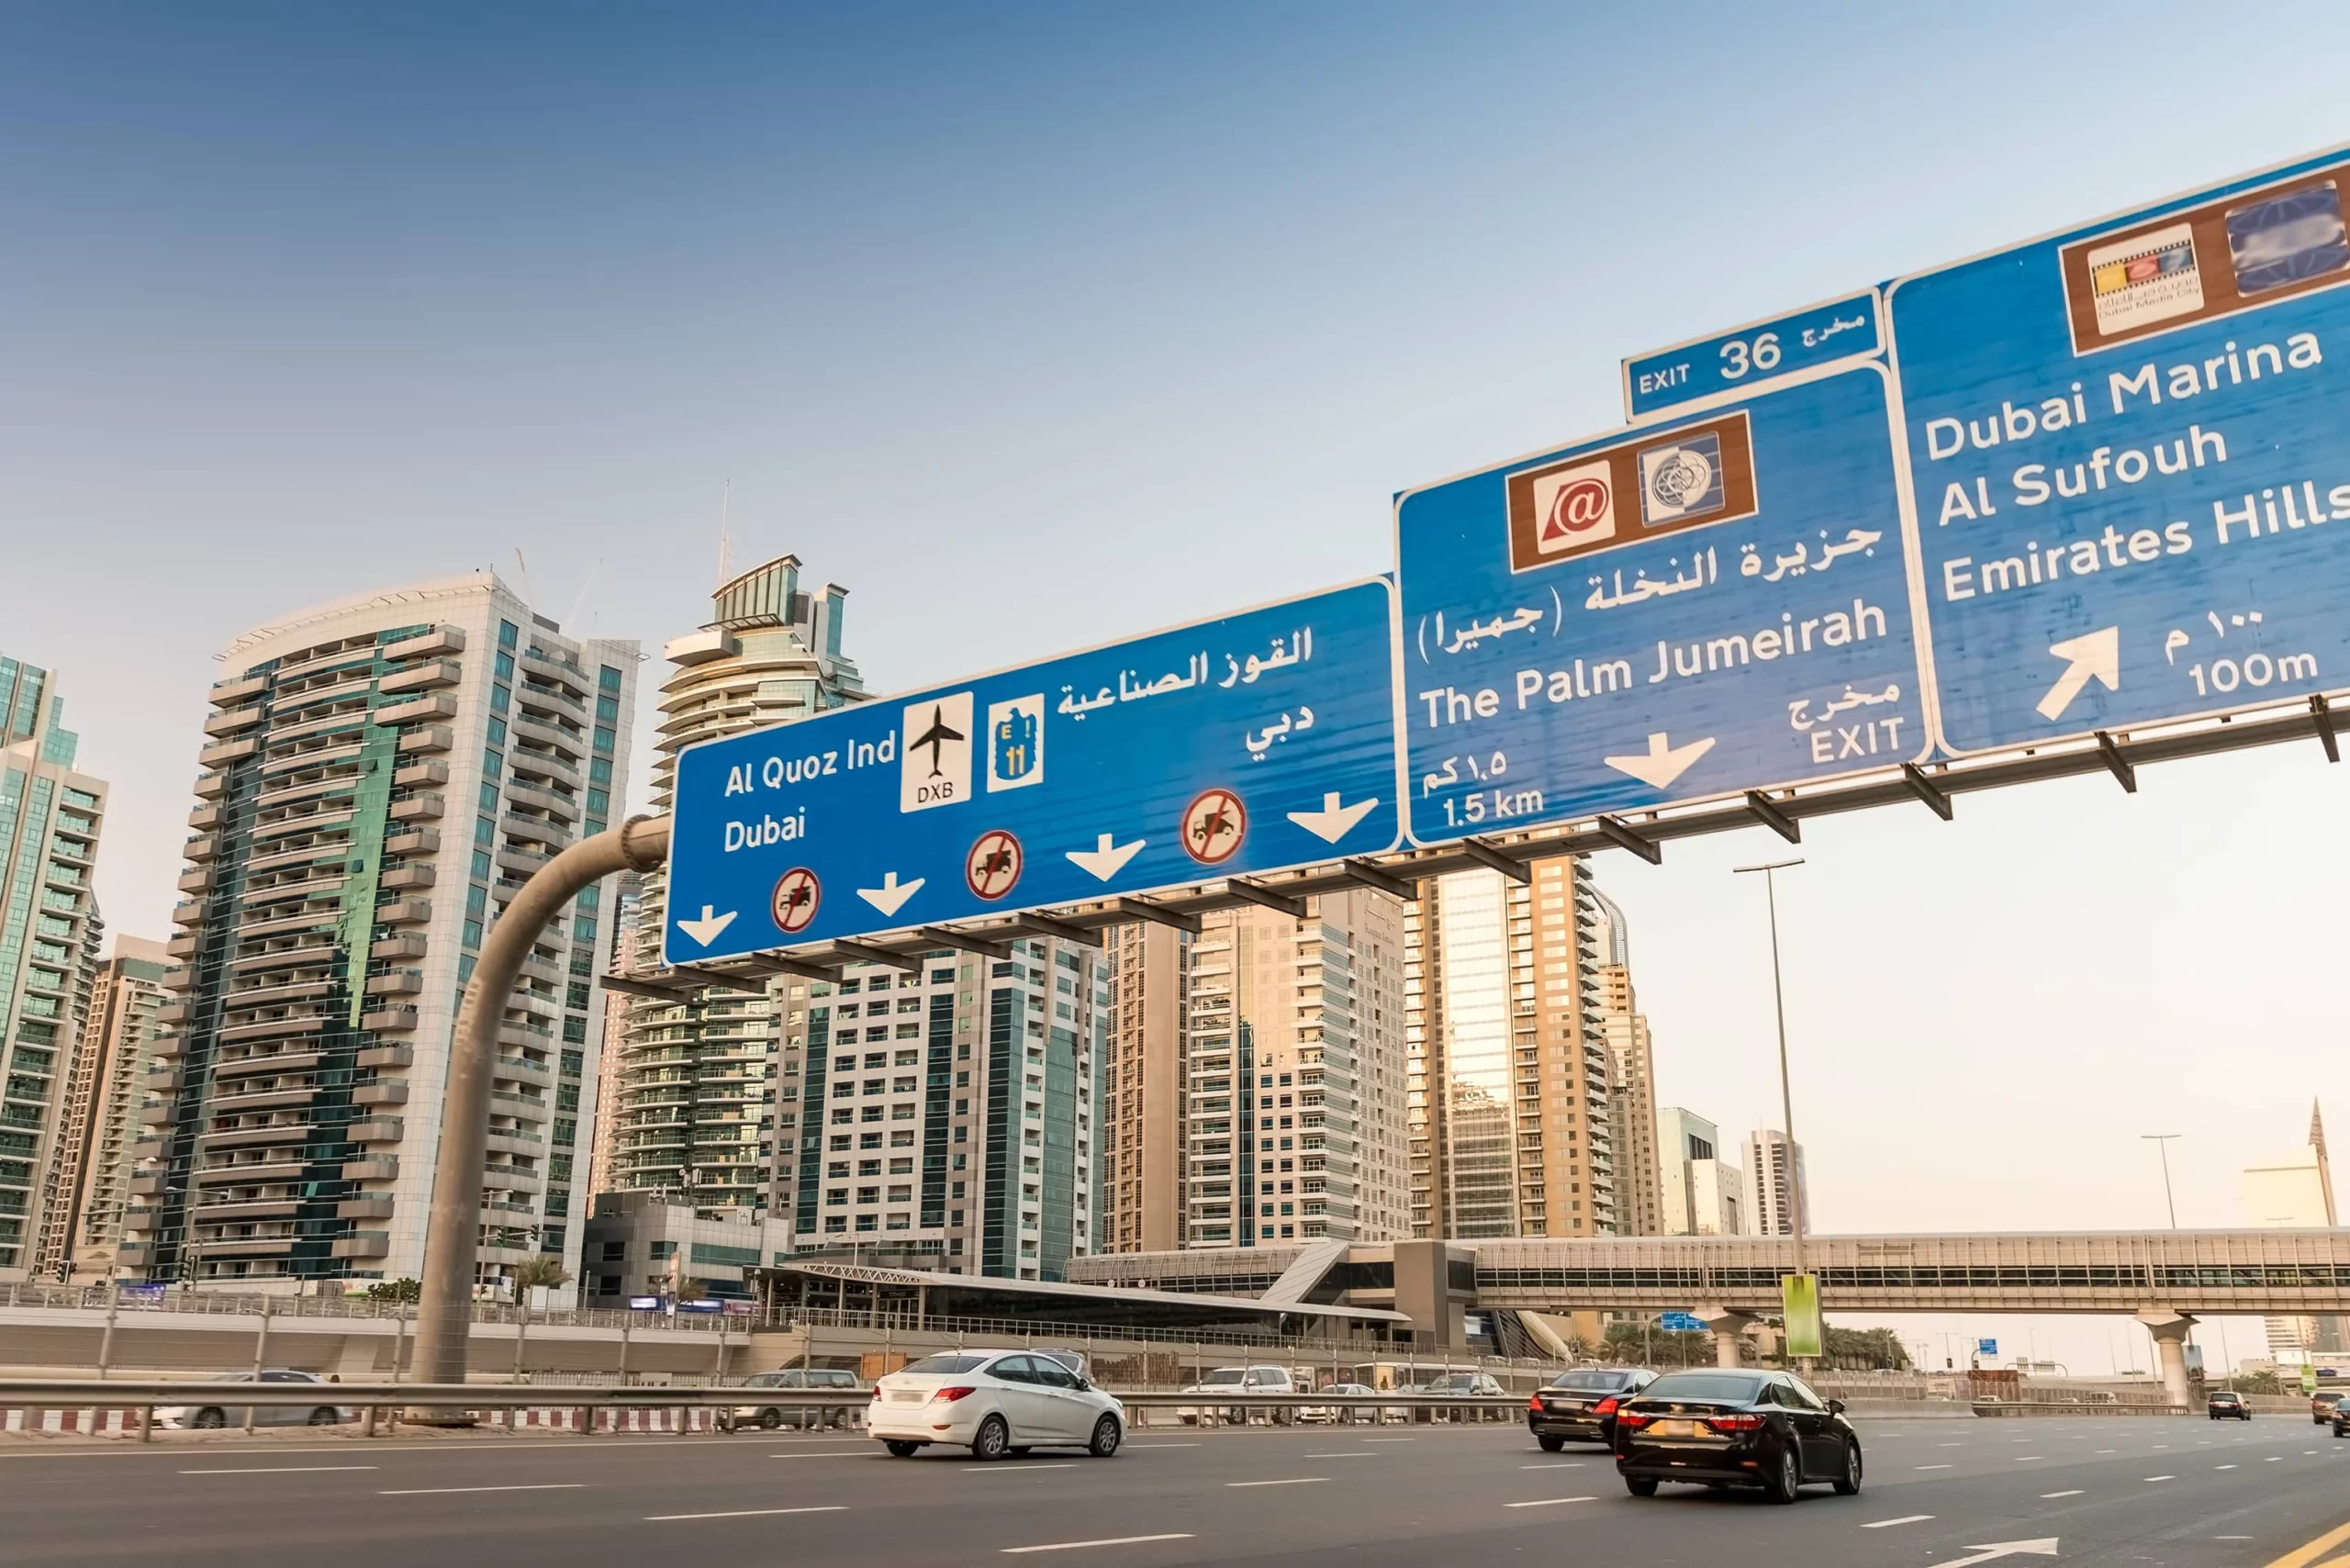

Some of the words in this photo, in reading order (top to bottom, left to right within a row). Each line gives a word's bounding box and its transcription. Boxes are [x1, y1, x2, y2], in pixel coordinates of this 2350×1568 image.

[1638, 363, 1690, 395] EXIT
[1719, 331, 1782, 379] 36
[1801, 315, 1866, 349] مخرج
[1925, 381, 2087, 462] Dubai
[2108, 332, 2323, 414] Marina
[1939, 476, 1997, 527] Al
[2011, 427, 2228, 506] Sufouh
[1740, 527, 1883, 582] جزيرة
[1942, 521, 2193, 602] Emirates
[2212, 480, 2350, 545] Hills
[1583, 546, 1718, 610] النخلة
[1057, 650, 1209, 719] الصناعية
[1219, 625, 1313, 689] القوز
[1419, 686, 1501, 728] The
[1516, 659, 1634, 710] Palm
[1650, 598, 1887, 684] Jumeirah
[2188, 653, 2319, 697] 100m
[1000, 722, 1012, 740] E
[1245, 705, 1315, 761] دبي
[1788, 682, 1903, 734] مخرج
[724, 763, 754, 797] Al
[762, 750, 838, 790] Quoz
[847, 730, 896, 770] Ind
[1006, 745, 1025, 776] 11
[1809, 719, 1902, 764] EXIT
[917, 781, 954, 804] DXB
[1422, 755, 1460, 797] كم
[723, 807, 805, 853] Dubai
[1442, 794, 1489, 827] 1.5
[1493, 788, 1545, 819] km
